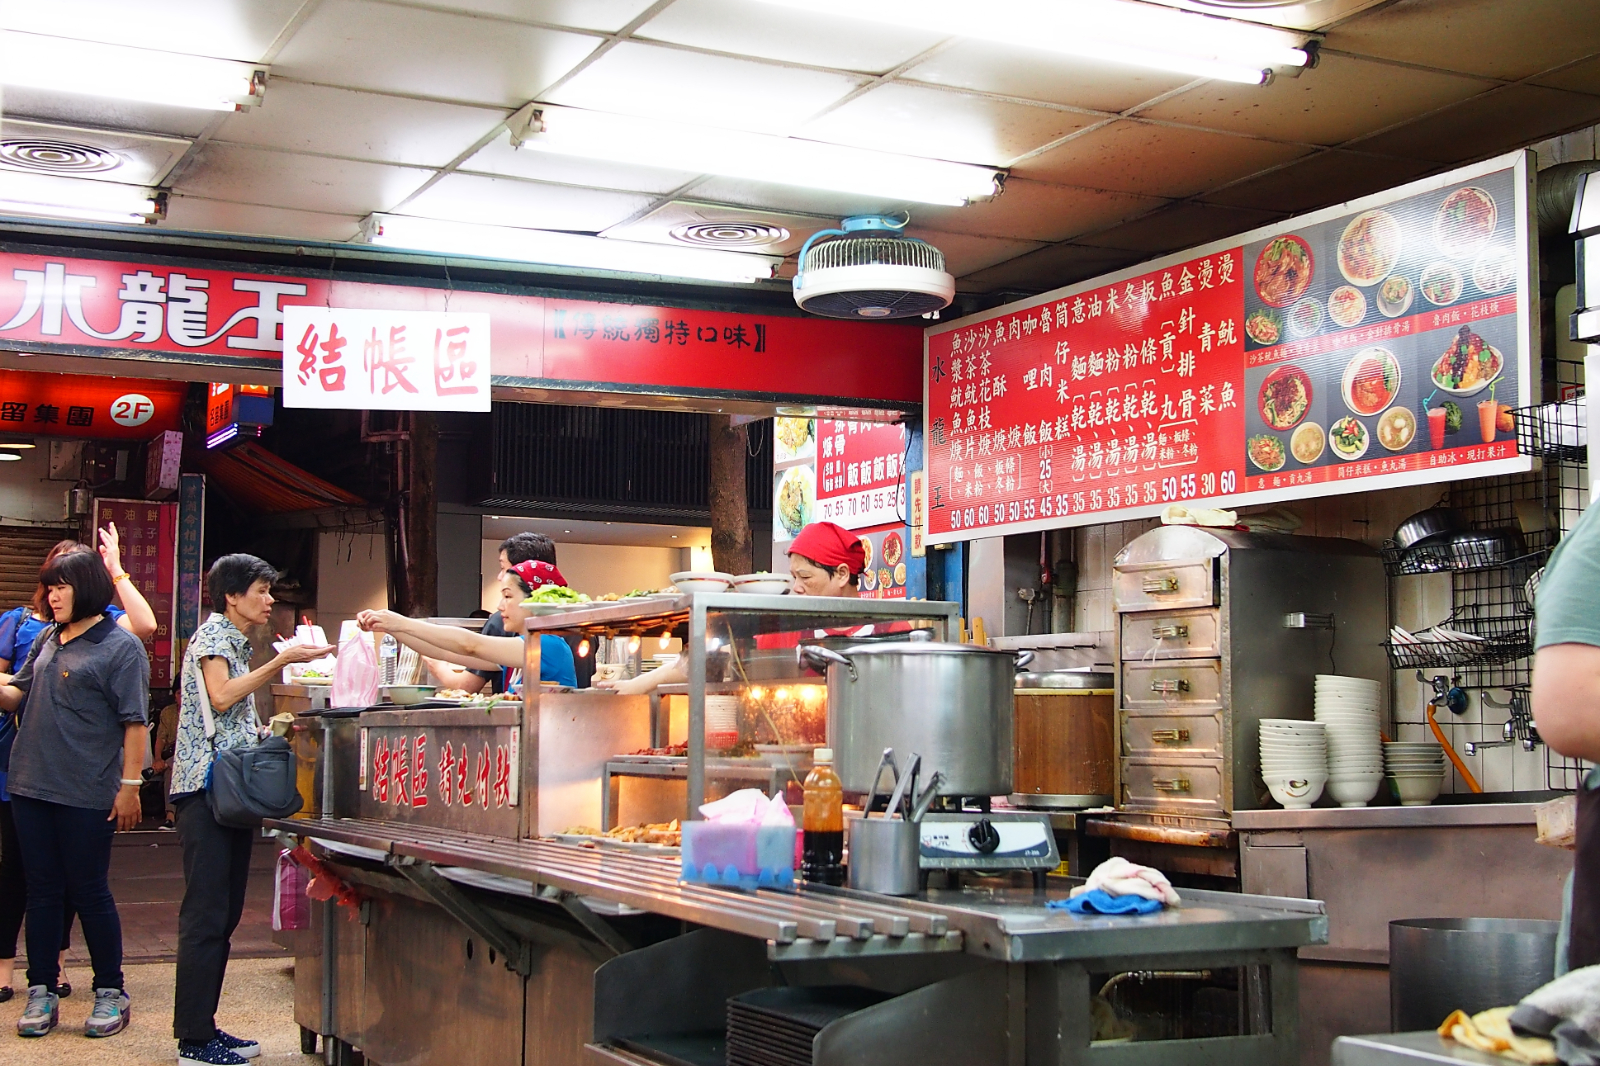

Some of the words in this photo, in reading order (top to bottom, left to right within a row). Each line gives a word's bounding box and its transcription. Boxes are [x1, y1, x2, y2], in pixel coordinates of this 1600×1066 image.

[0, 262, 307, 351] 水龍王
[1197, 259, 1216, 416] 燙青菜
[1218, 253, 1238, 409] 燙魷魚
[1177, 266, 1197, 419] 金針排骨
[296, 322, 479, 397] 結帳區
[1038, 311, 1054, 444] 魯肉飯
[1054, 301, 1071, 441] 筒仔米糕
[963, 328, 979, 460] 沙茶魷魚片
[114, 402, 151, 419] 2F
[931, 355, 947, 510] 水龍王
[1039, 459, 1052, 480] 25
[1143, 480, 1156, 503] 35
[1161, 477, 1177, 501] 50
[1180, 473, 1196, 499] 55
[1201, 472, 1215, 495] 30
[1220, 470, 1236, 493] 60
[861, 494, 870, 513] 60
[874, 493, 883, 509] 55
[887, 491, 896, 507] 25
[1055, 494, 1069, 516] 35
[1072, 491, 1085, 513] 35
[1089, 489, 1102, 511] 35
[1107, 486, 1120, 508] 35
[1125, 483, 1138, 506] 35
[824, 503, 832, 519] 70
[835, 500, 843, 516] 55
[848, 498, 856, 516] 70
[978, 505, 989, 525] 60
[994, 503, 1005, 523] 50
[1009, 501, 1020, 522] 50
[1023, 499, 1035, 519] 55
[1040, 496, 1053, 517] 45
[950, 510, 961, 529] 50
[964, 508, 975, 528] 60
[373, 732, 429, 808] 結帳區
[438, 740, 514, 811] 請先付款
